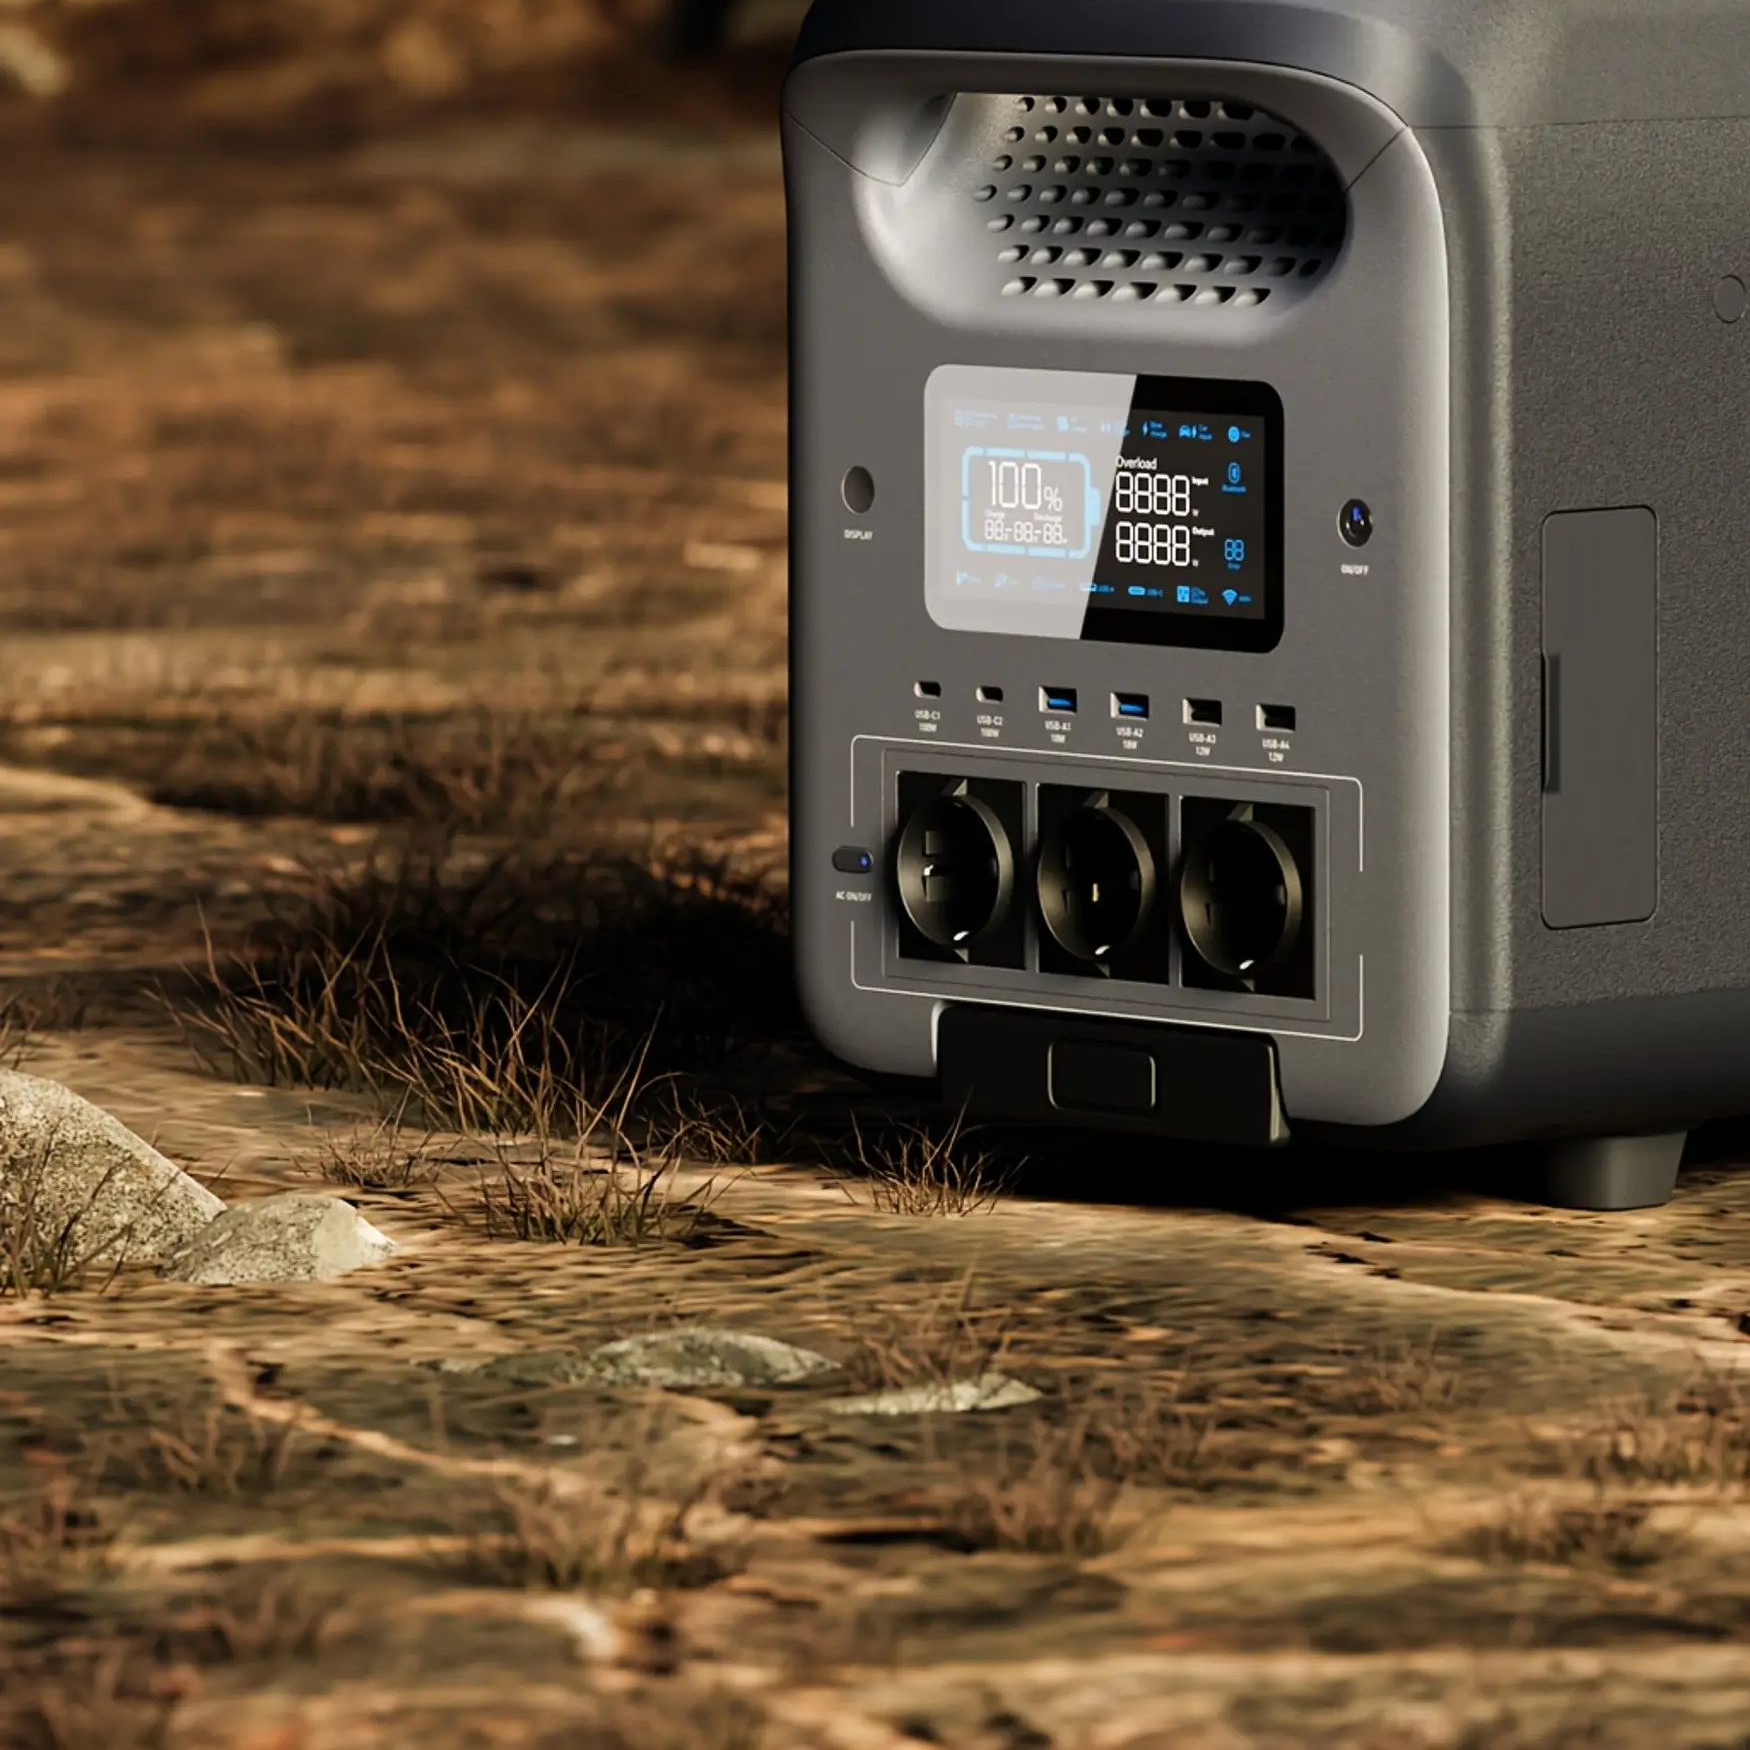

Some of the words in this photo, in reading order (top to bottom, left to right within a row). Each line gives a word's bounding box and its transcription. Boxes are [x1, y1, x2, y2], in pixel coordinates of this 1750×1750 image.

[1115, 455, 1158, 470] Overload
[1115, 471, 1190, 517] 8888
[844, 529, 873, 540] DISPLAY
[1115, 521, 1190, 567] 8888
[1341, 563, 1369, 576] ON/OFF
[914, 709, 941, 720] USB-C1
[976, 714, 1004, 726] USB-C2
[1044, 720, 1071, 732] USB-A1
[1116, 727, 1143, 738] USB-A2
[1188, 732, 1216, 744] USB-A3
[1262, 738, 1290, 750] USB-A4
[1195, 746, 1211, 756] 12W
[1268, 751, 1284, 762] 12W
